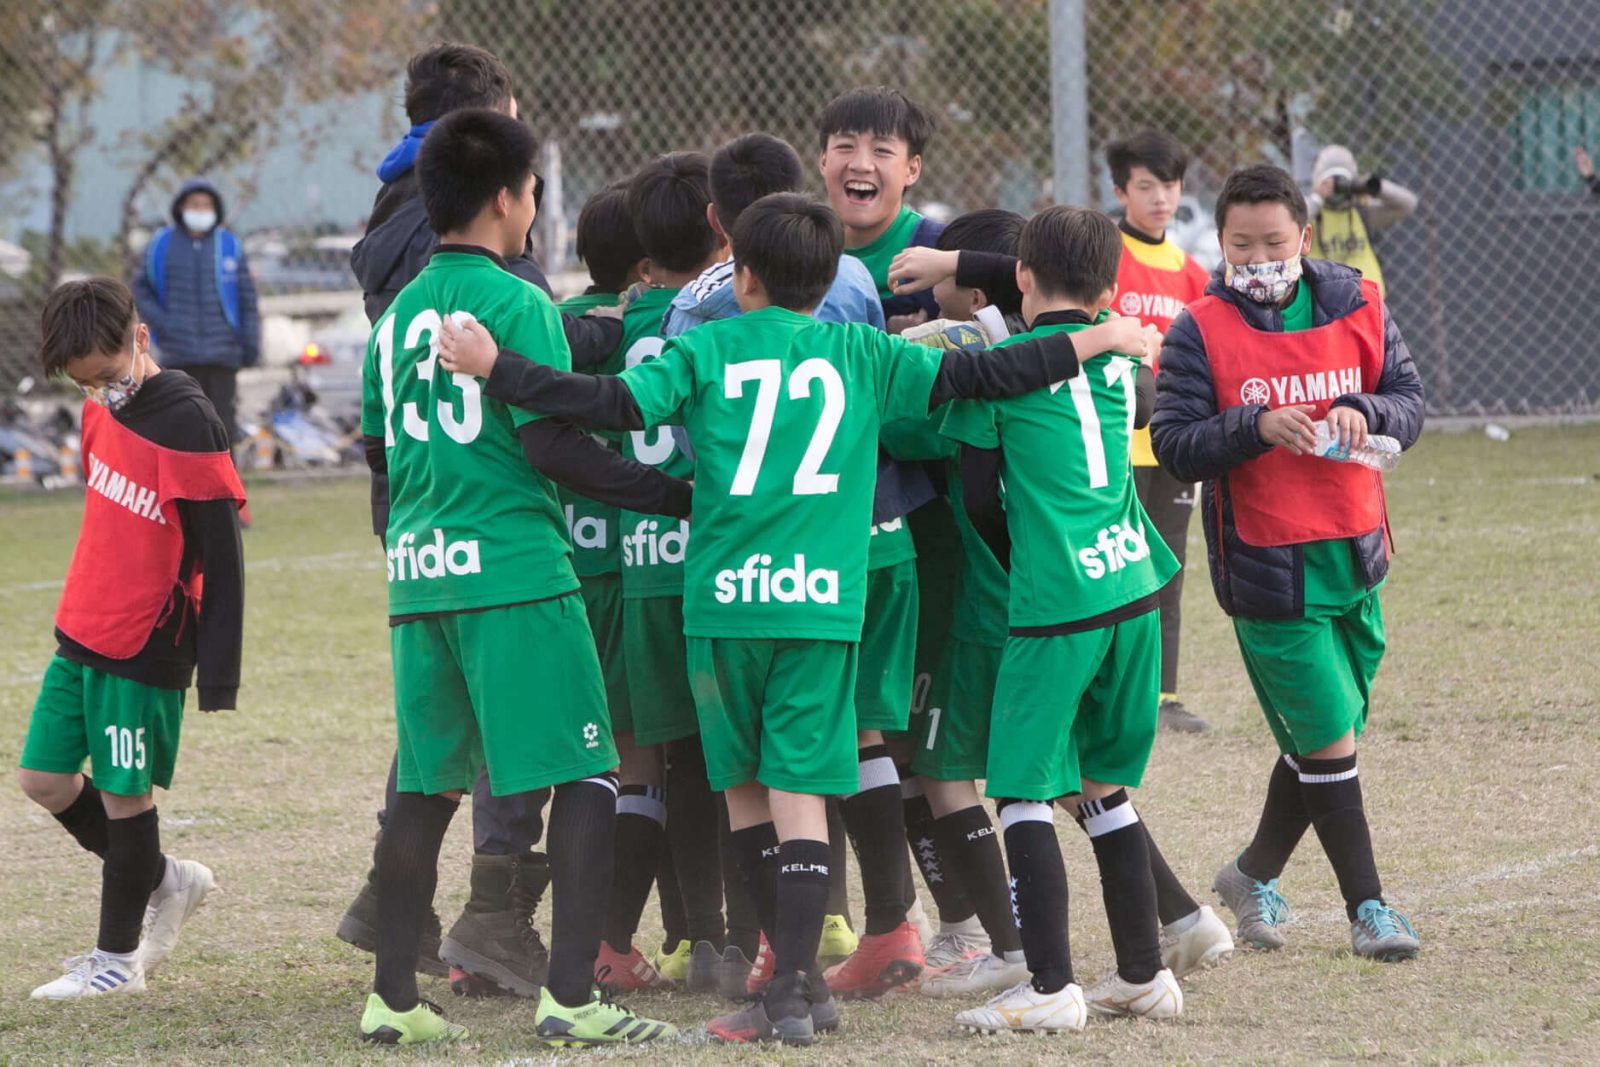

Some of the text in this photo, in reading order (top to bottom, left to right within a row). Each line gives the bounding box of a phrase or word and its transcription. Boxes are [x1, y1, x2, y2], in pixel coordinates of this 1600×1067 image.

[1141, 293, 1184, 320] YAMA
[374, 308, 482, 447] 133
[1271, 366, 1362, 405] YAMAHA
[724, 358, 846, 495] 72
[1048, 355, 1138, 489] 11
[88, 458, 166, 525] YAMAHA
[387, 528, 481, 582] sfida
[623, 519, 690, 567] sfid
[1078, 518, 1150, 579] sfid
[714, 553, 839, 604] sfida
[104, 725, 146, 770] 105
[926, 707, 941, 751] 1
[967, 826, 995, 840] KEL
[781, 863, 829, 875] KELME
